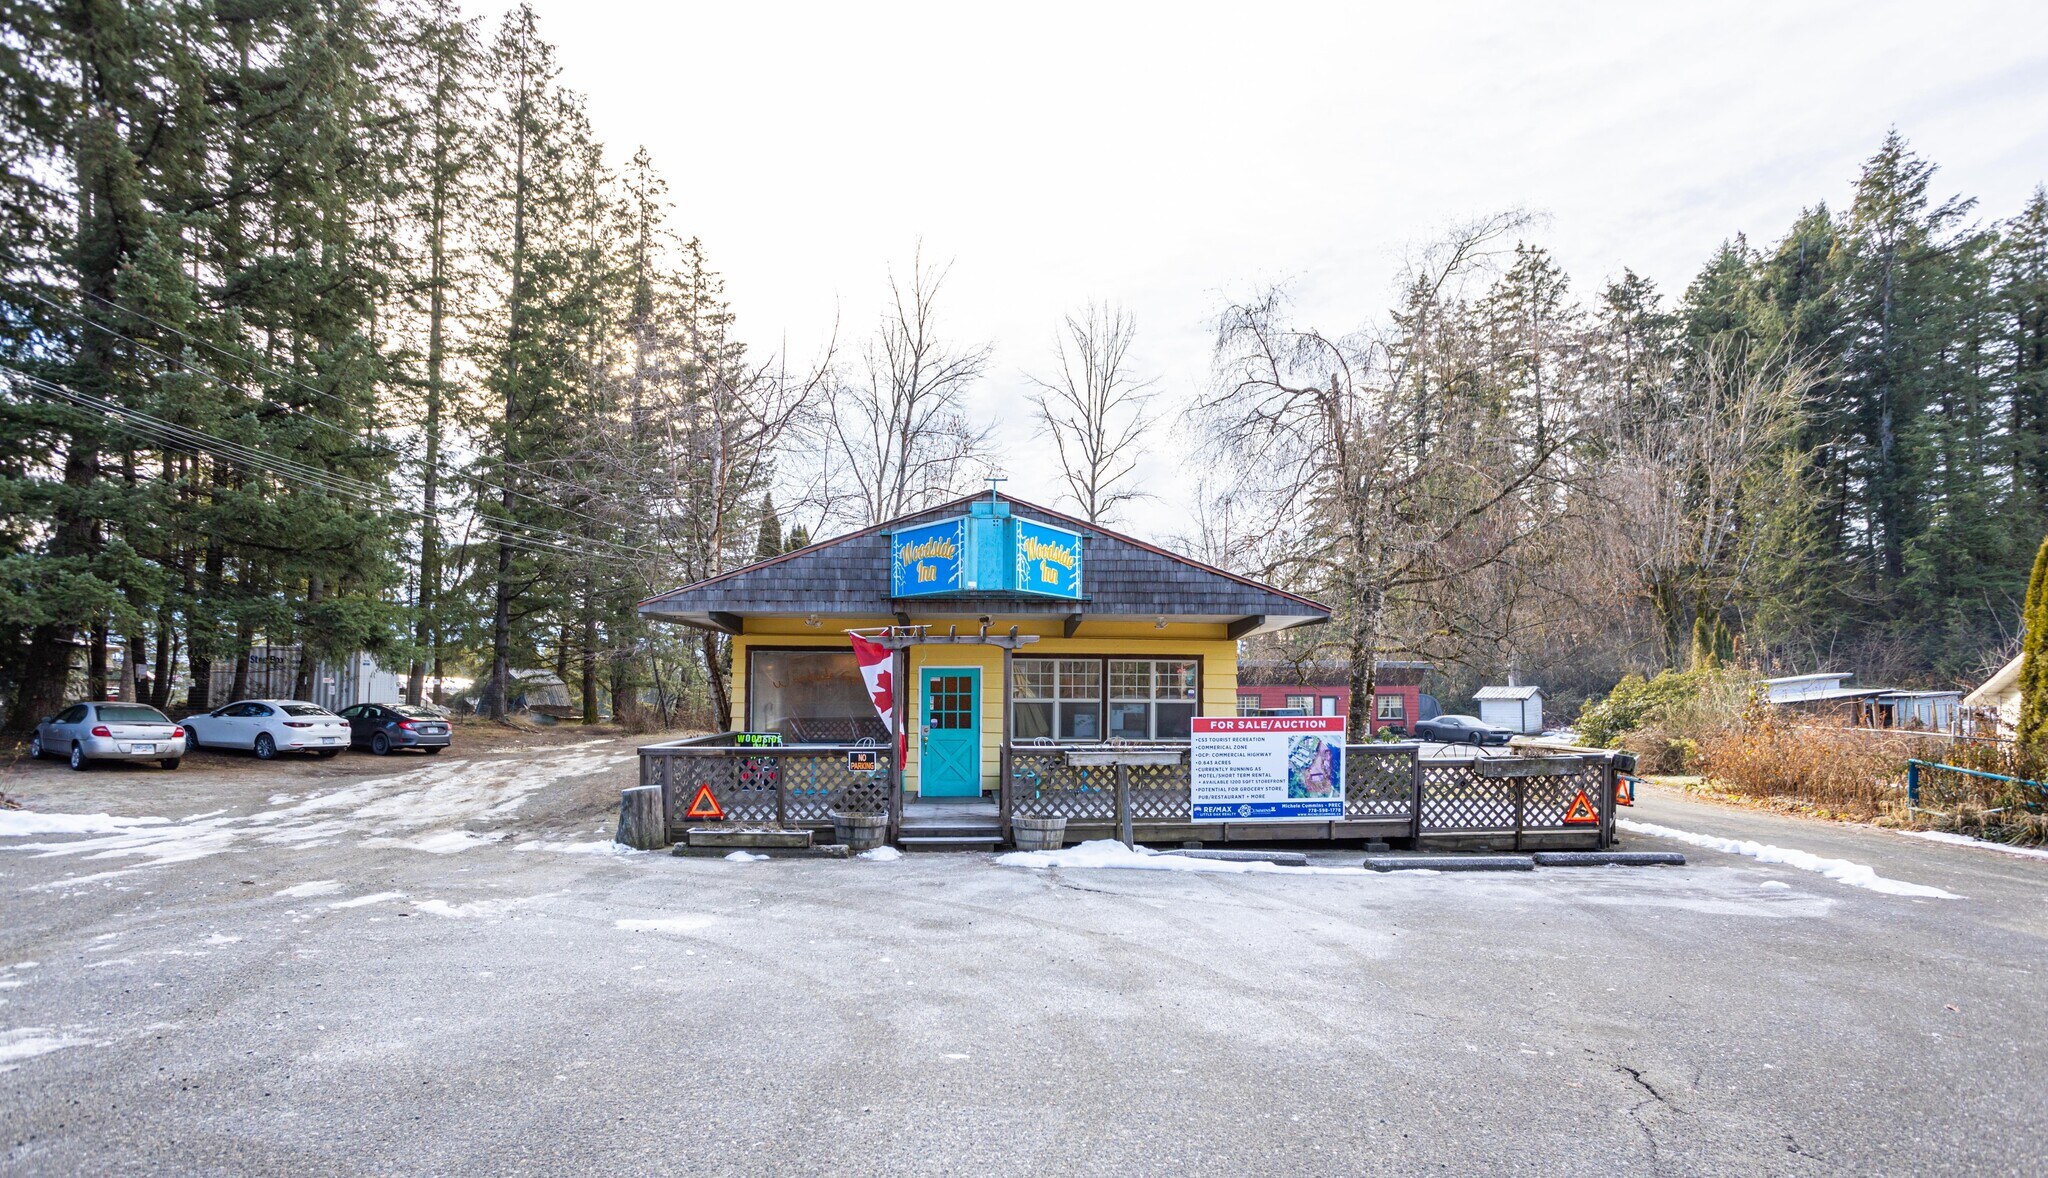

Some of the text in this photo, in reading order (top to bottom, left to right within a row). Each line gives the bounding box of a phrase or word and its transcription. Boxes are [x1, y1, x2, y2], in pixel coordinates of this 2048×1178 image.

[900, 536, 956, 567] Woodside
[1023, 535, 1074, 570] Woodside
[917, 560, 937, 583] Inn
[1040, 560, 1058, 585] Inn
[1211, 720, 1326, 730] FOR SALE/AUCTION
[737, 734, 782, 743] WOODSIDE
[851, 762, 874, 770] PARKING
